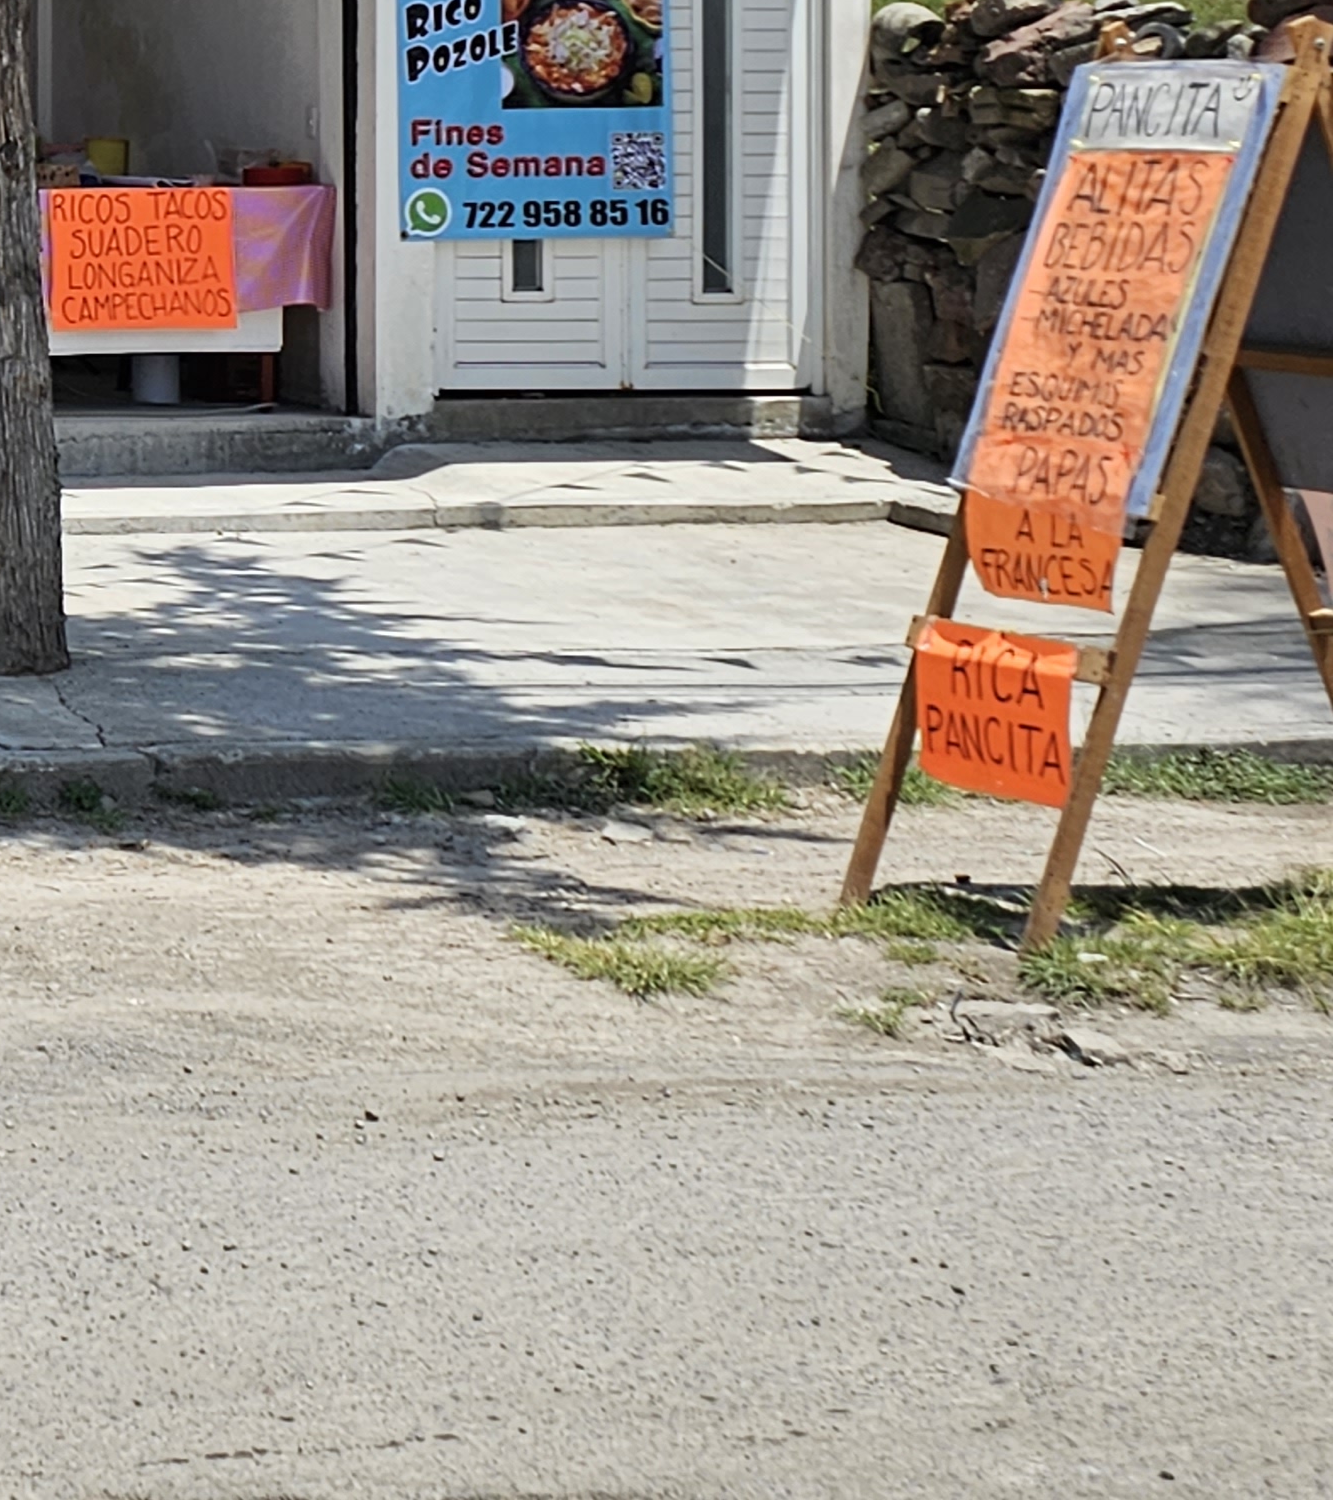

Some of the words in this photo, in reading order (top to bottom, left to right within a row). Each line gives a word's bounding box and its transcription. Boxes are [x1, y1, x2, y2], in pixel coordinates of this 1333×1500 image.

[1083, 81, 1223, 138] PANCITA
[410, 119, 505, 147] Fines
[410, 152, 454, 180] de
[465, 151, 607, 179] Semana
[51, 192, 132, 225] RICOS
[146, 189, 229, 222] TACOS
[1067, 158, 1210, 217] ALITAS
[461, 201, 517, 229] 722
[522, 200, 583, 228] 958
[589, 199, 630, 228] 85
[635, 198, 670, 226] 16
[70, 223, 203, 260] SUADERO
[1043, 219, 1198, 274] BEBIDAS
[67, 255, 222, 290] LONGANIZA
[61, 287, 233, 325] CAMPECHANOS
[1090, 346, 1146, 376] MAS
[1011, 446, 1112, 505] PAPAS
[1014, 507, 1035, 544] A
[1049, 509, 1084, 549] LA
[980, 547, 1114, 599] FRANCESA
[950, 637, 1045, 711] RICA
[925, 703, 1067, 786] PANCITA
